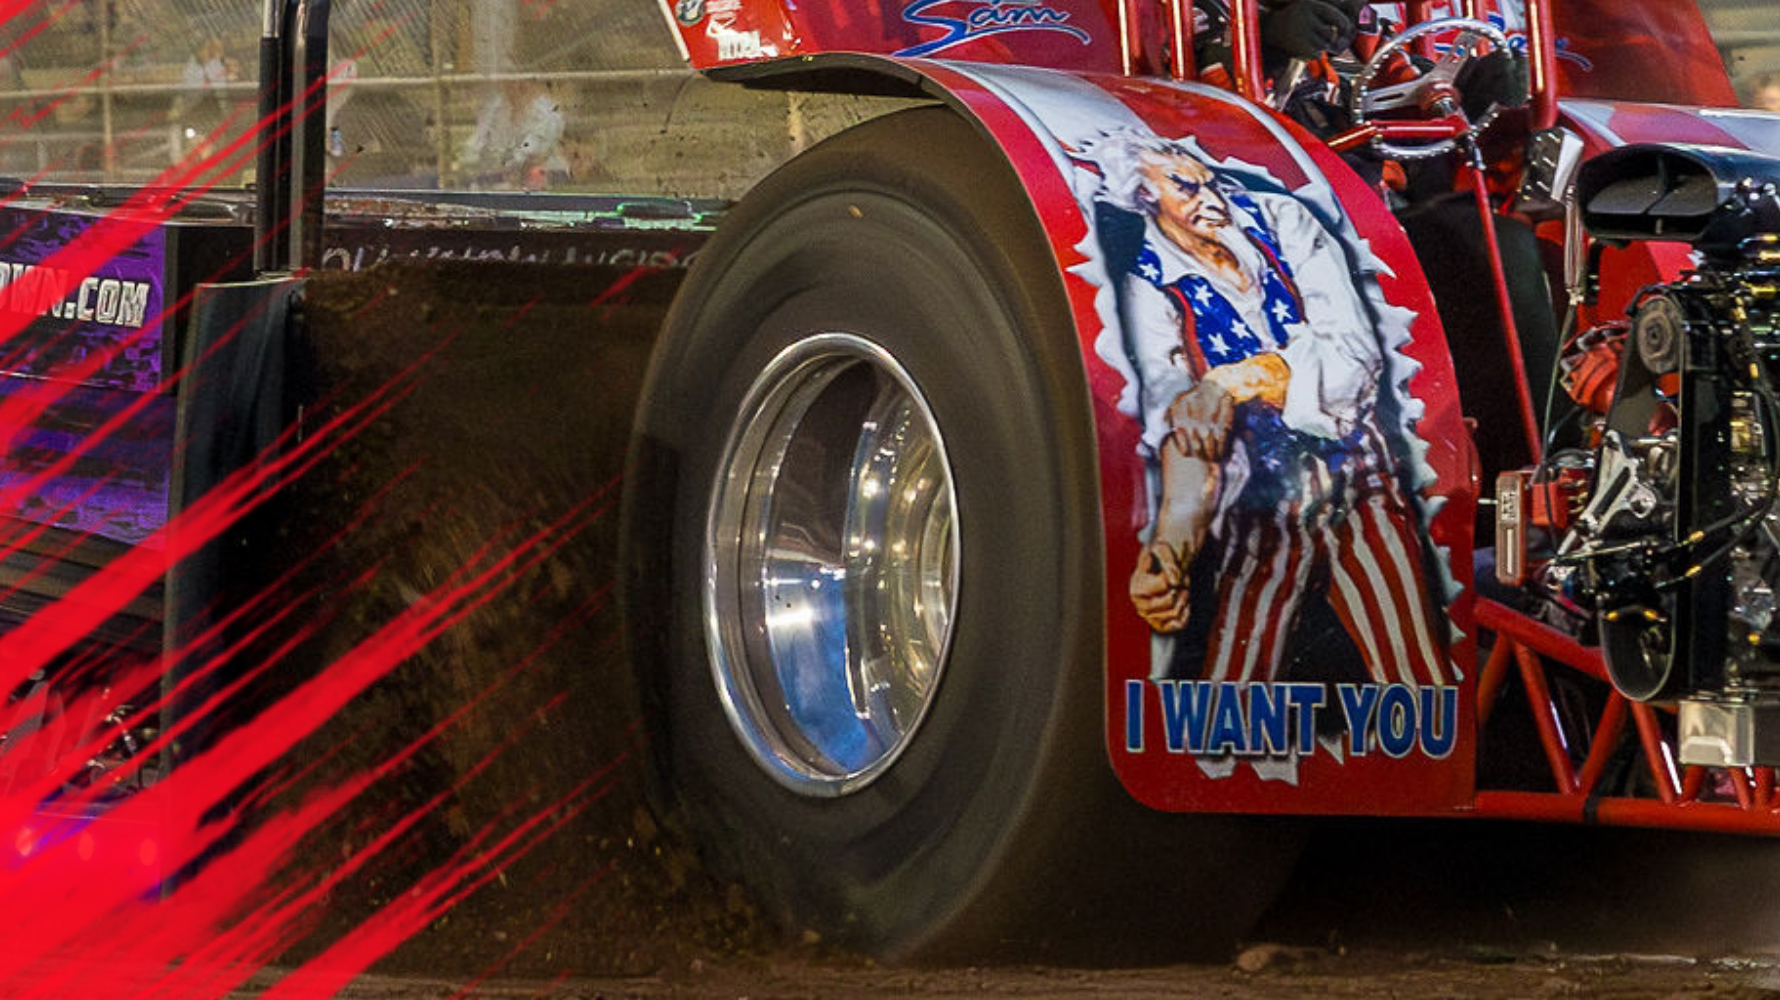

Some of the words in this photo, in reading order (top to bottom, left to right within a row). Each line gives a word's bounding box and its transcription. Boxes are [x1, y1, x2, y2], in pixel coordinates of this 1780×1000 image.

[1124, 679, 1145, 753] I
[1158, 679, 1326, 756] WANT
[1335, 683, 1459, 760] YOU
